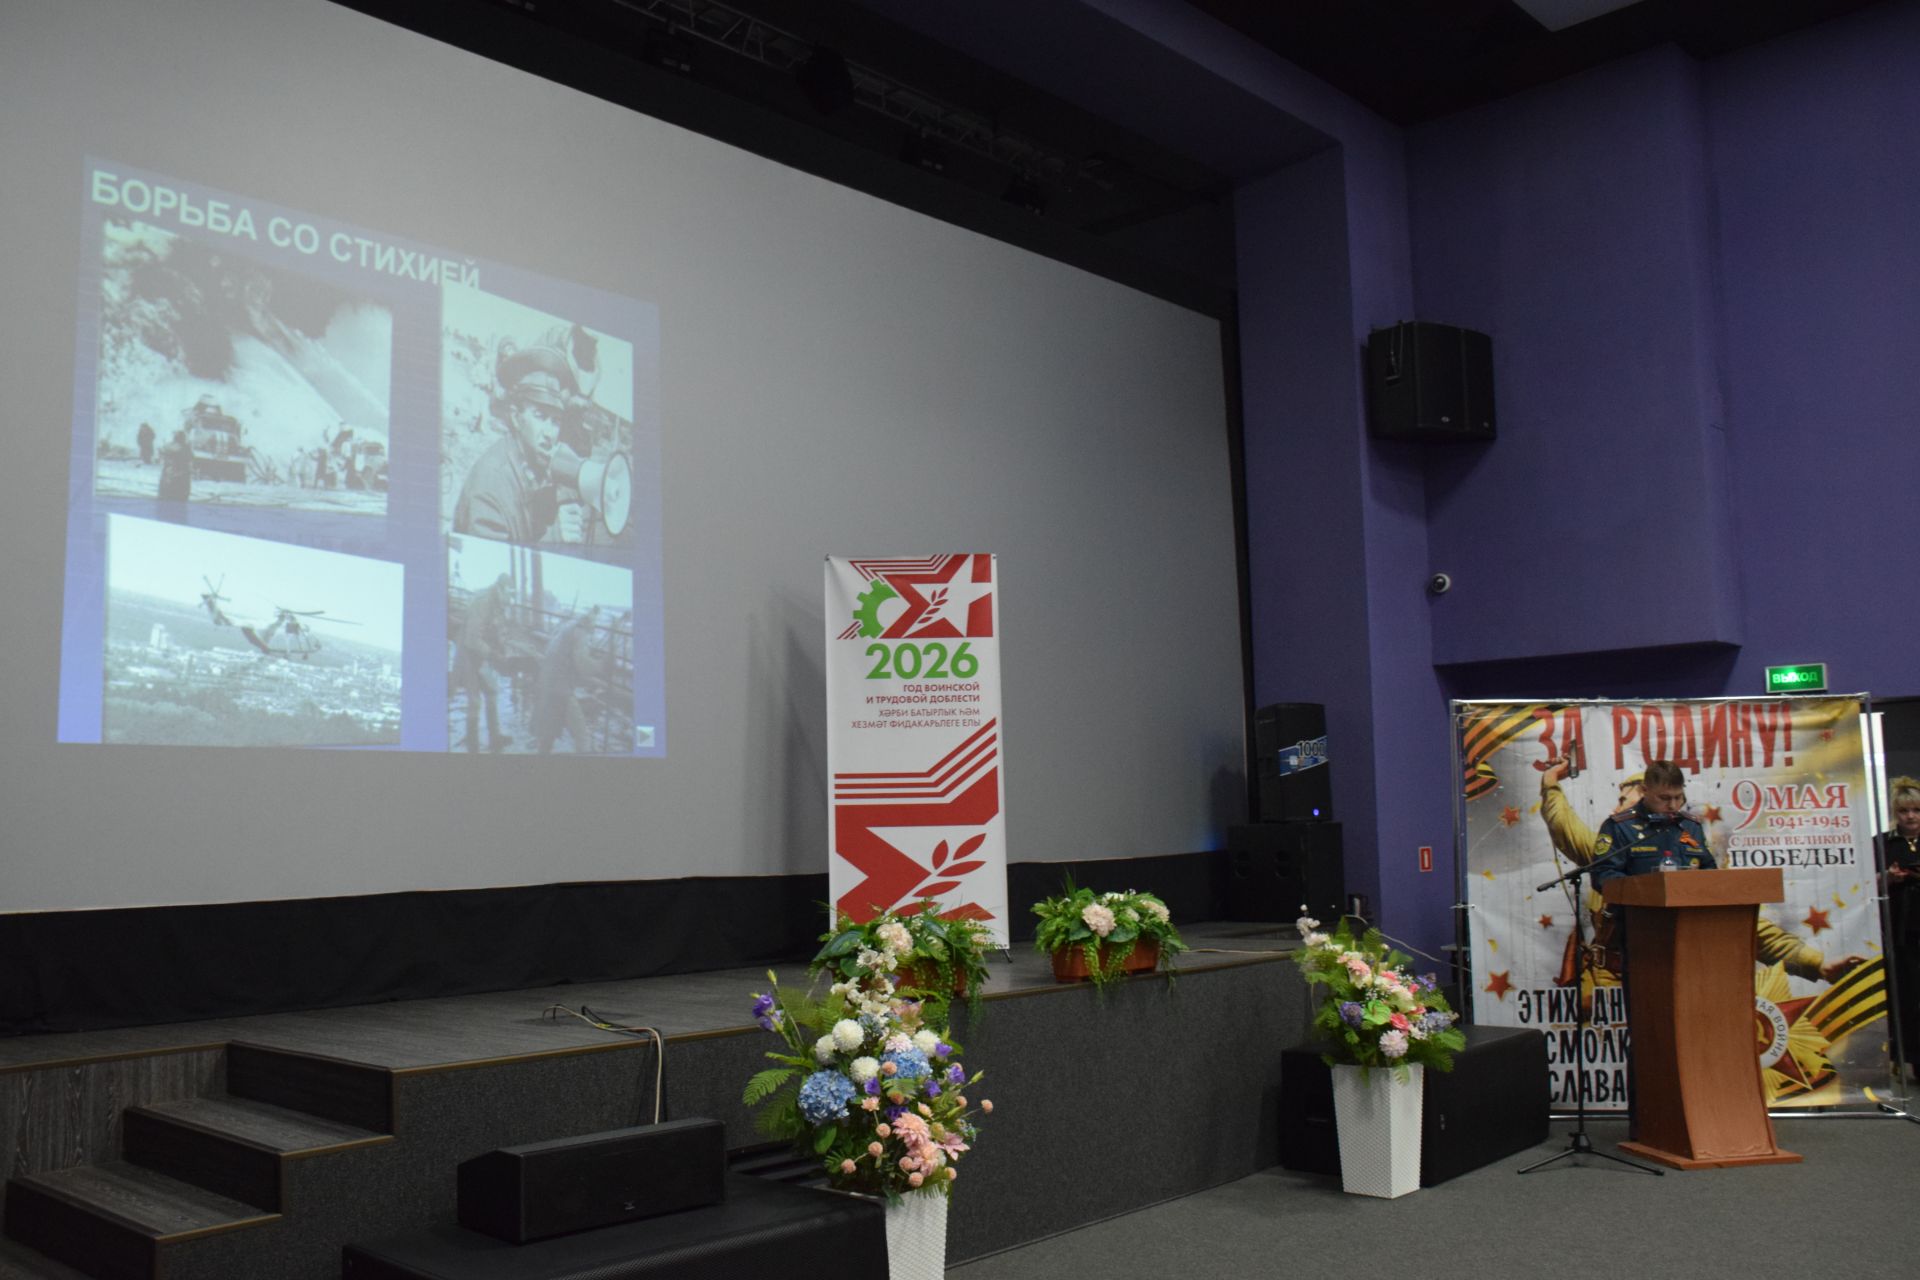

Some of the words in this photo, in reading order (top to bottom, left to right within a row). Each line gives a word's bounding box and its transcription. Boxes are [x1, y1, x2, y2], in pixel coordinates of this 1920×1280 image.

[92, 170, 258, 240] БОРЬБА
[268, 217, 319, 254] СО
[330, 233, 480, 290] СТИХИЕЙ
[865, 642, 979, 680] 2026
[866, 696, 874, 704] И
[876, 694, 927, 704] ТРУДОВОЙ
[930, 694, 980, 704] ДОБЛЕСТИ
[904, 684, 922, 693] ГОД
[925, 682, 979, 692] ВОИНСКОЙ
[911, 708, 957, 717] БАТЫРЛЫК
[963, 718, 980, 727] ЕЛЫ
[1532, 704, 1587, 771] ЗА
[1612, 703, 1793, 774] РОДИНУ!
[1731, 780, 1762, 830] 9
[1766, 785, 1849, 810] МАЯ
[1768, 815, 1850, 829] 1941-1945
[1731, 837, 1740, 846] С
[1743, 836, 1780, 846] ДНЕМ
[1784, 833, 1852, 845] ВЕЛИКОЙ
[1730, 848, 1855, 868] ПОБЕДЫ!
[1518, 989, 1578, 1023] ЭТИХ
[1593, 988, 1624, 1025] ДН
[1545, 1030, 1630, 1064] СМОЛК
[1548, 1069, 1626, 1103] СЛАВА
